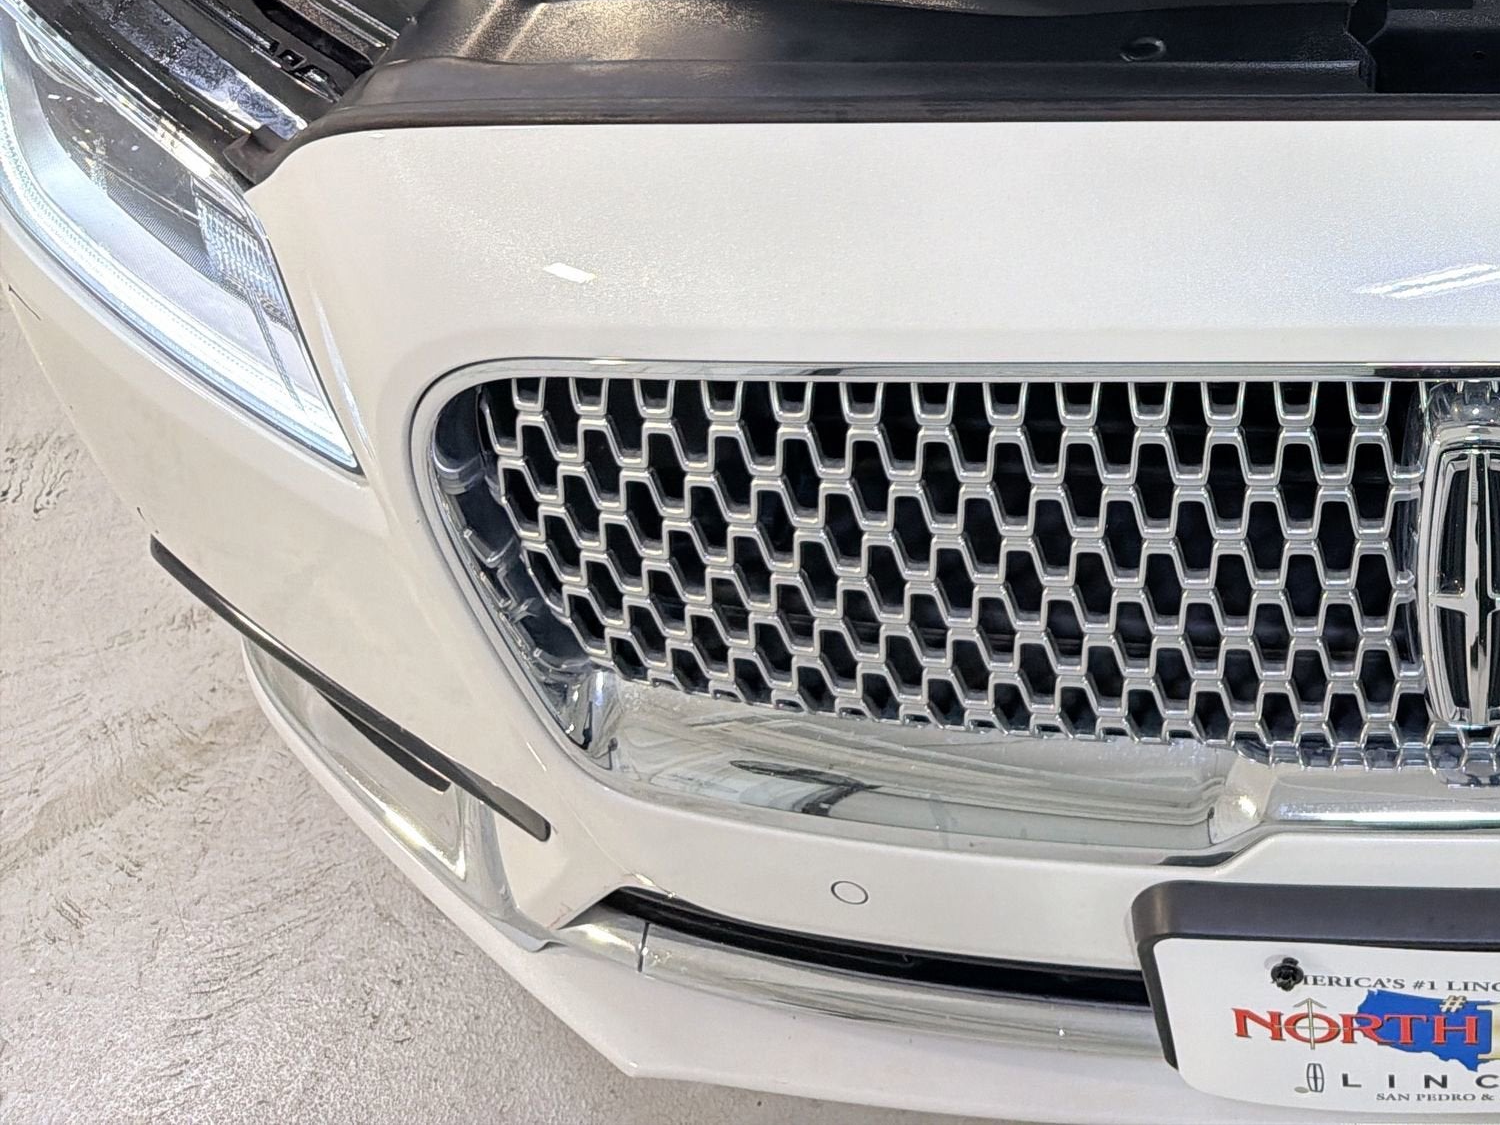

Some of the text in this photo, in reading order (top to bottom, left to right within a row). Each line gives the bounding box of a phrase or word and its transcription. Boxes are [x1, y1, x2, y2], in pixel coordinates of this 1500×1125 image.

[1271, 974, 1406, 990] ERICA'S
[1412, 979, 1438, 991] #1
[1232, 1007, 1479, 1046] NORTH
[1376, 1092, 1410, 1102] SAN
[1416, 1092, 1476, 1102] PEDRO
[1481, 1092, 1495, 1102] &
